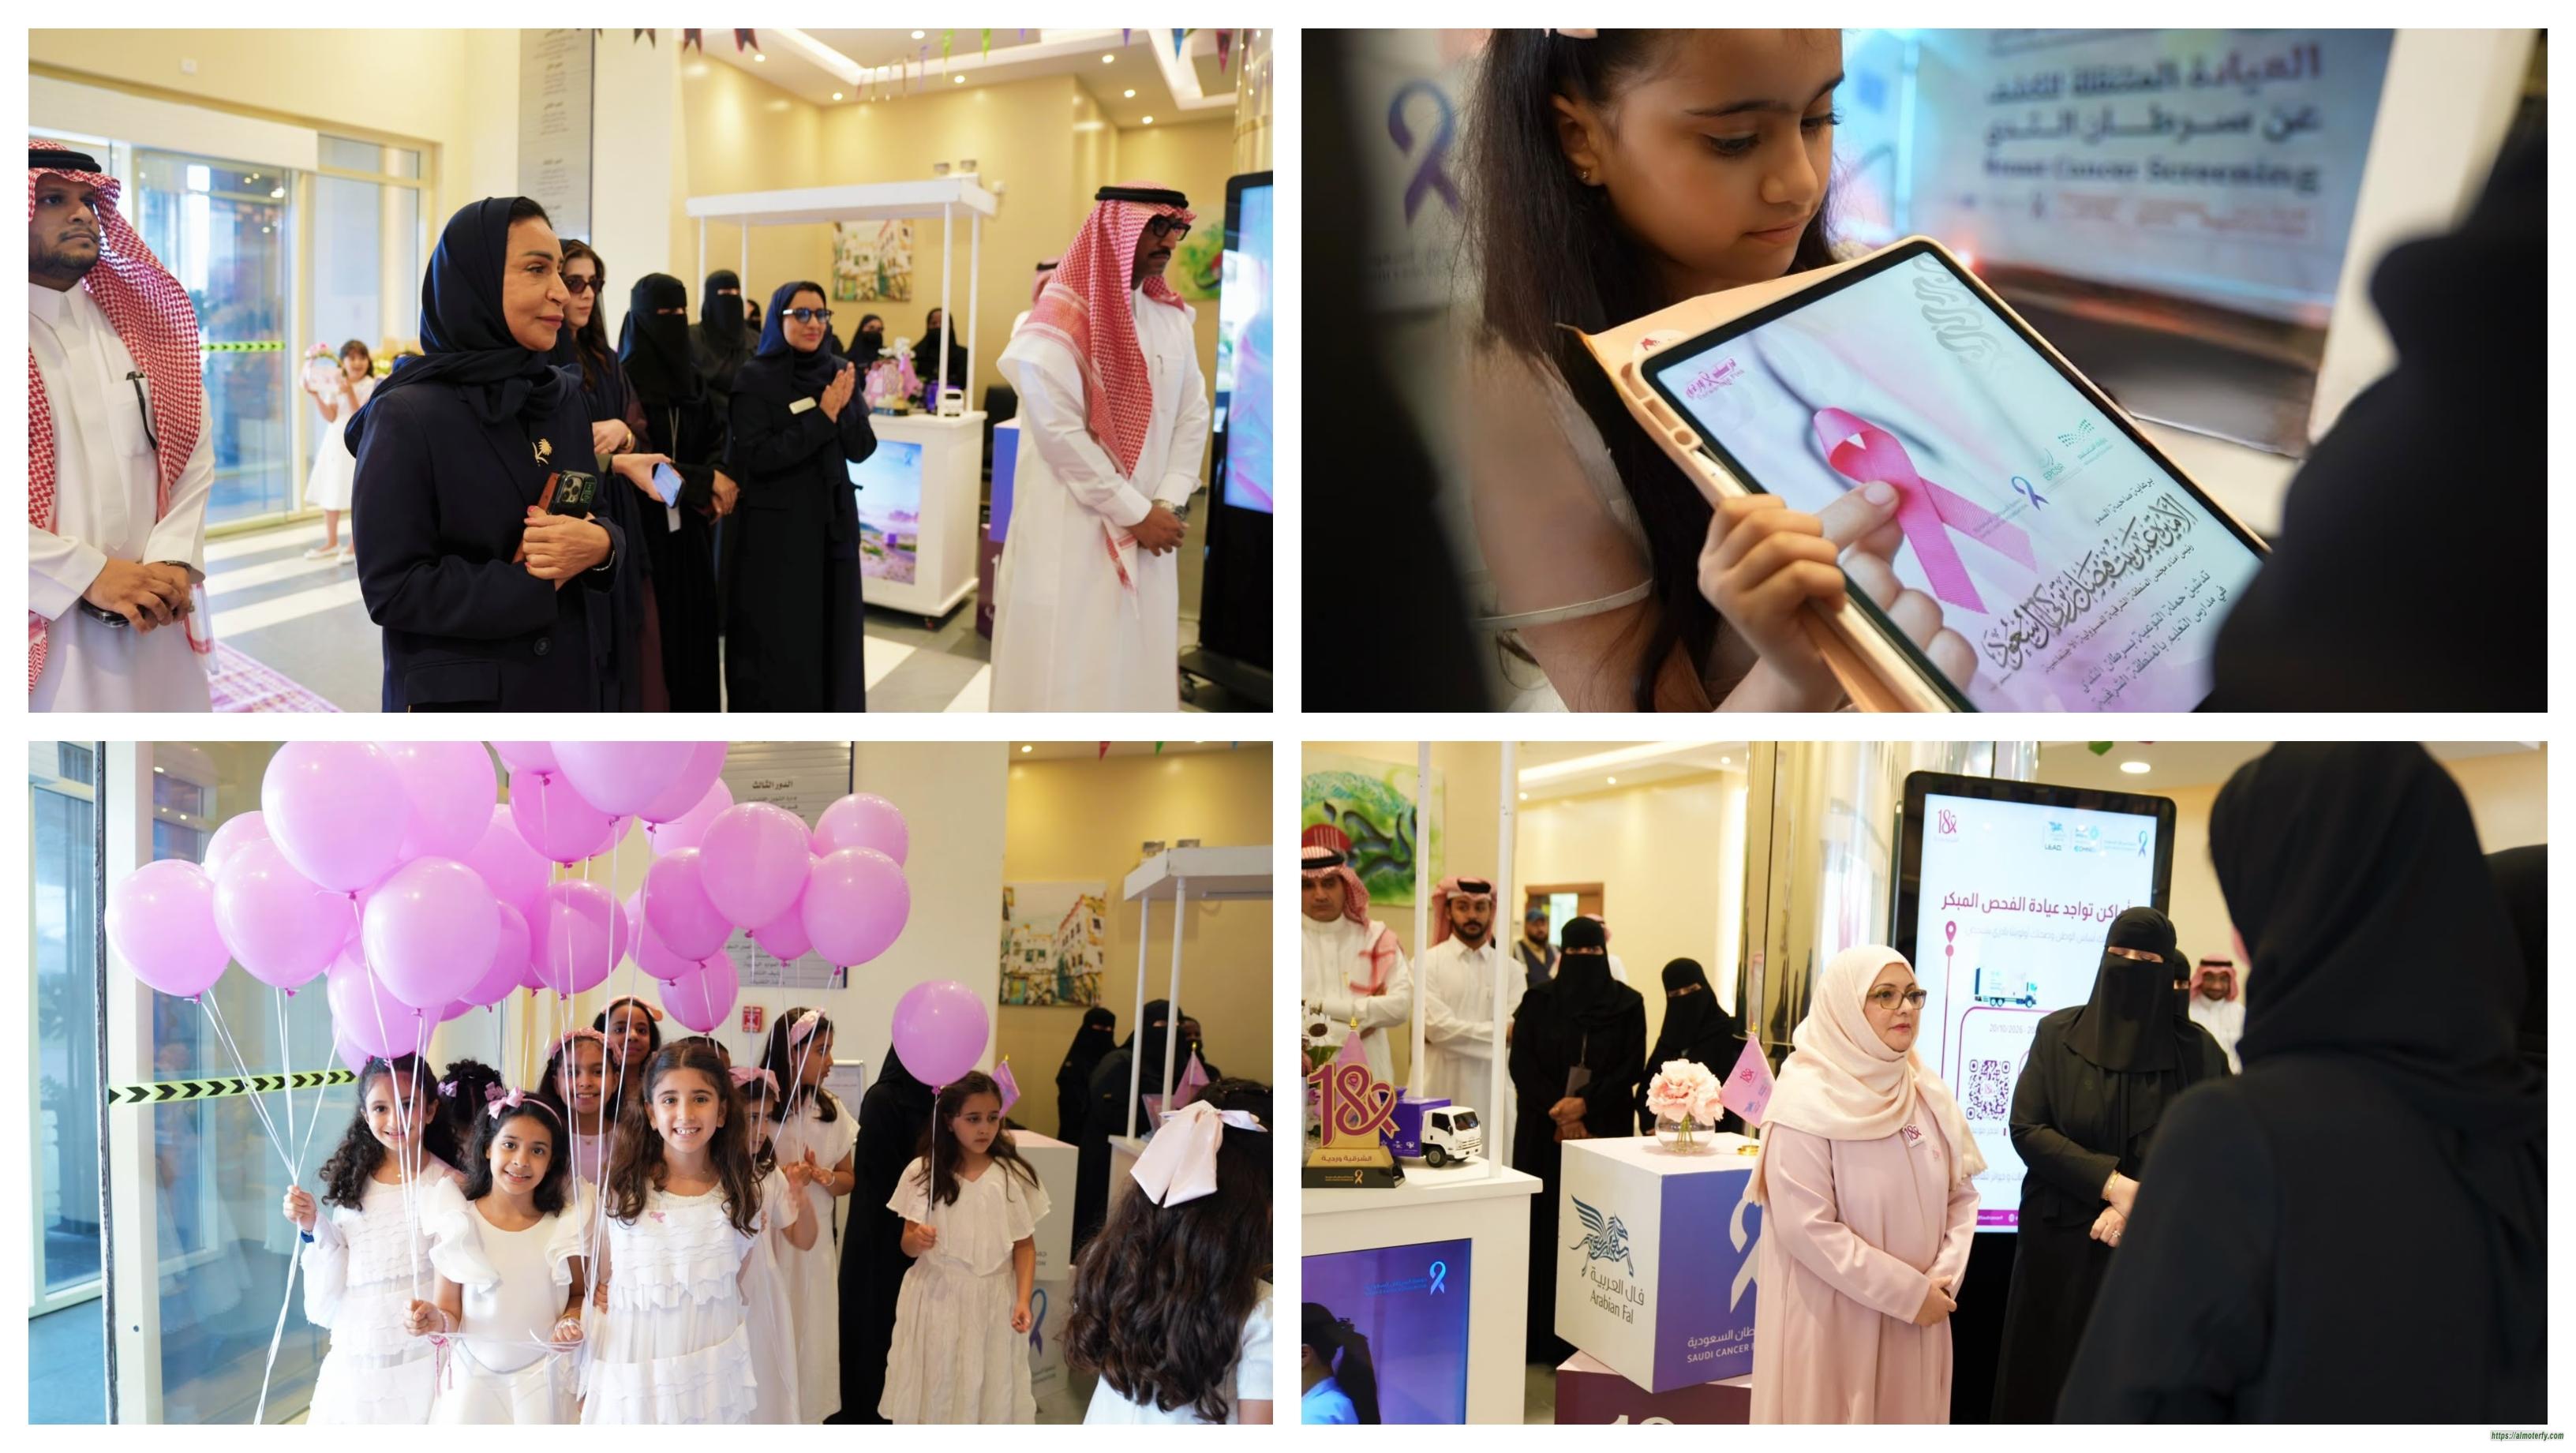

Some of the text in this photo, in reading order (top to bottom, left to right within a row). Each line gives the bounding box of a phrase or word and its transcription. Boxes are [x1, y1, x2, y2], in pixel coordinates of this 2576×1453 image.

[752, 779, 773, 789] الثالث
[1941, 892, 1979, 911] المبكر
[1982, 897, 2026, 914] الفحص
[2029, 898, 2059, 918] عيادة
[2062, 901, 2095, 921] تواجد
[1307, 1062, 1378, 1148] 18
[1590, 1266, 1645, 1306] فال العربية
[1590, 1290, 1634, 1324] Arabian Fal
[1687, 1329, 1733, 1349] السعودية
[1687, 1350, 1713, 1363] SAUDI
[1716, 1343, 1749, 1358] CANCER
